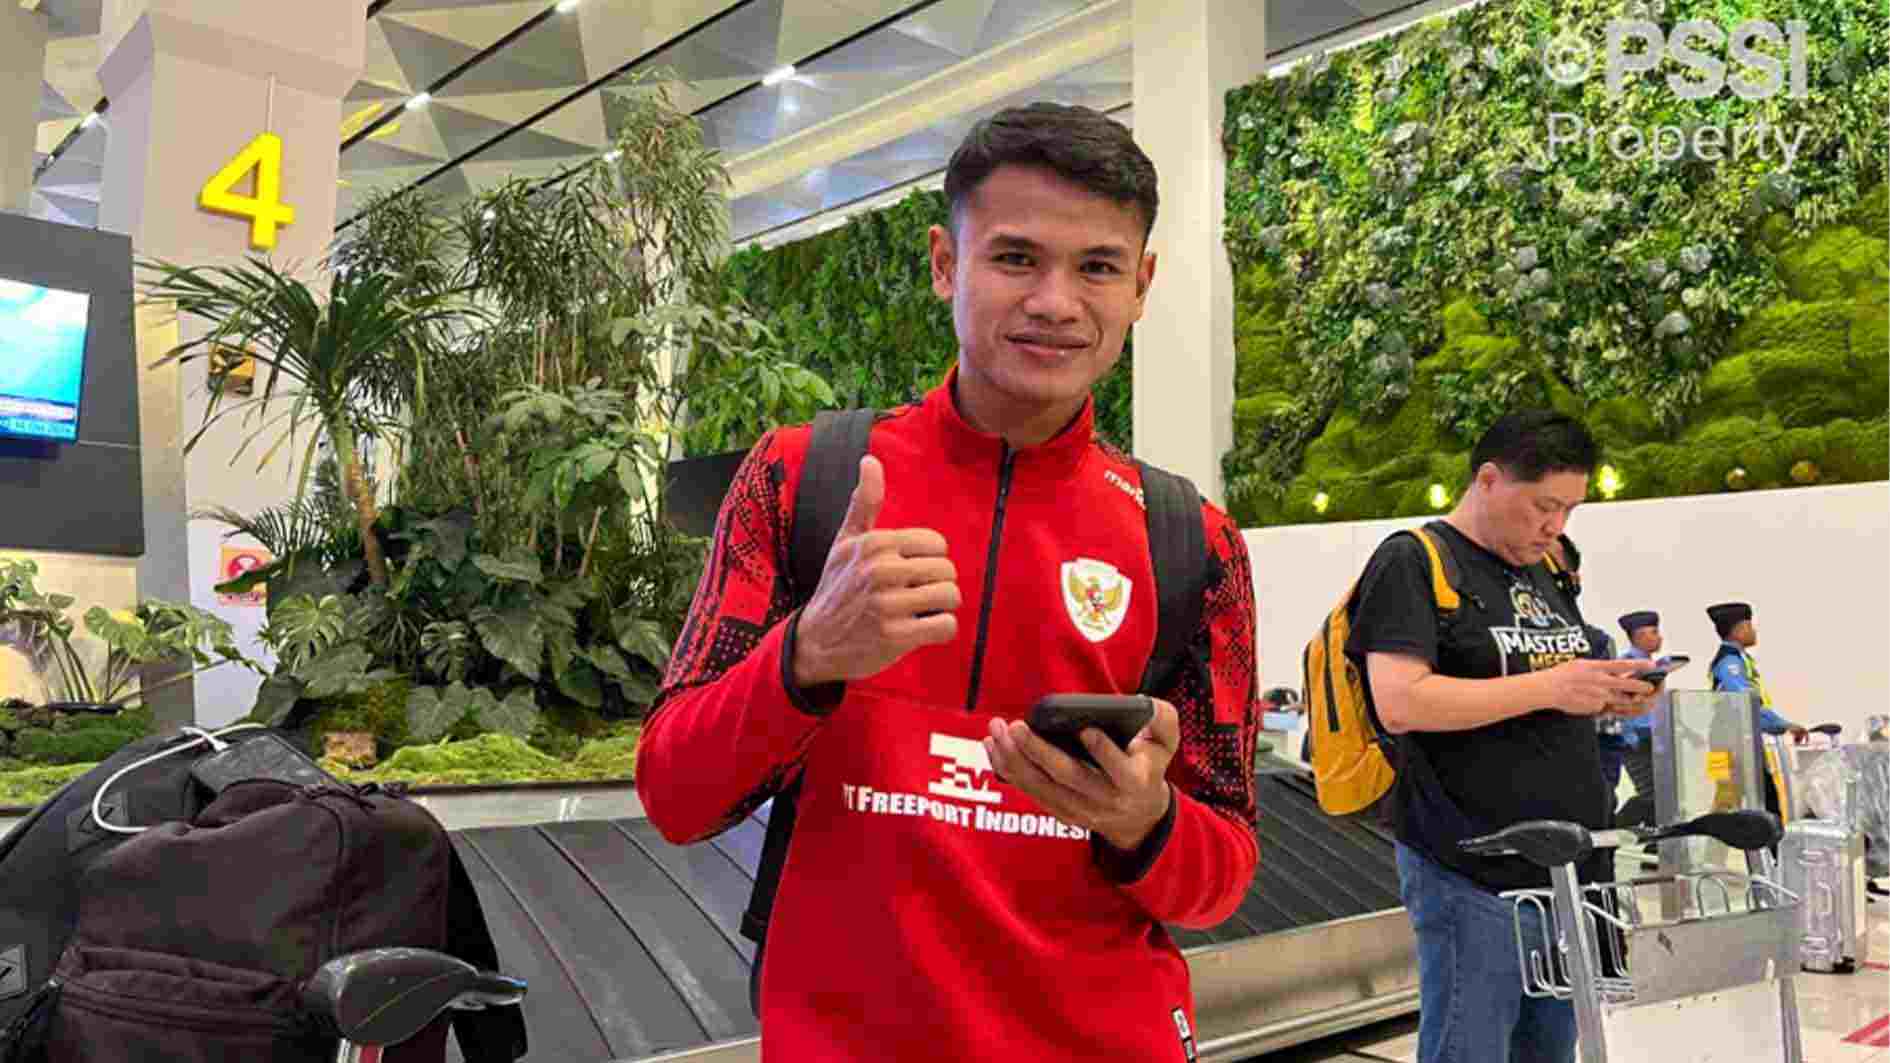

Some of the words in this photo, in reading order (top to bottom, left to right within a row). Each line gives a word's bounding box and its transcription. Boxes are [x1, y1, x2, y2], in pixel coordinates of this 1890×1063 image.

[201, 132, 295, 249] 4
[1500, 631, 1591, 654] MASTERS
[857, 786, 973, 829] FREEPORT
